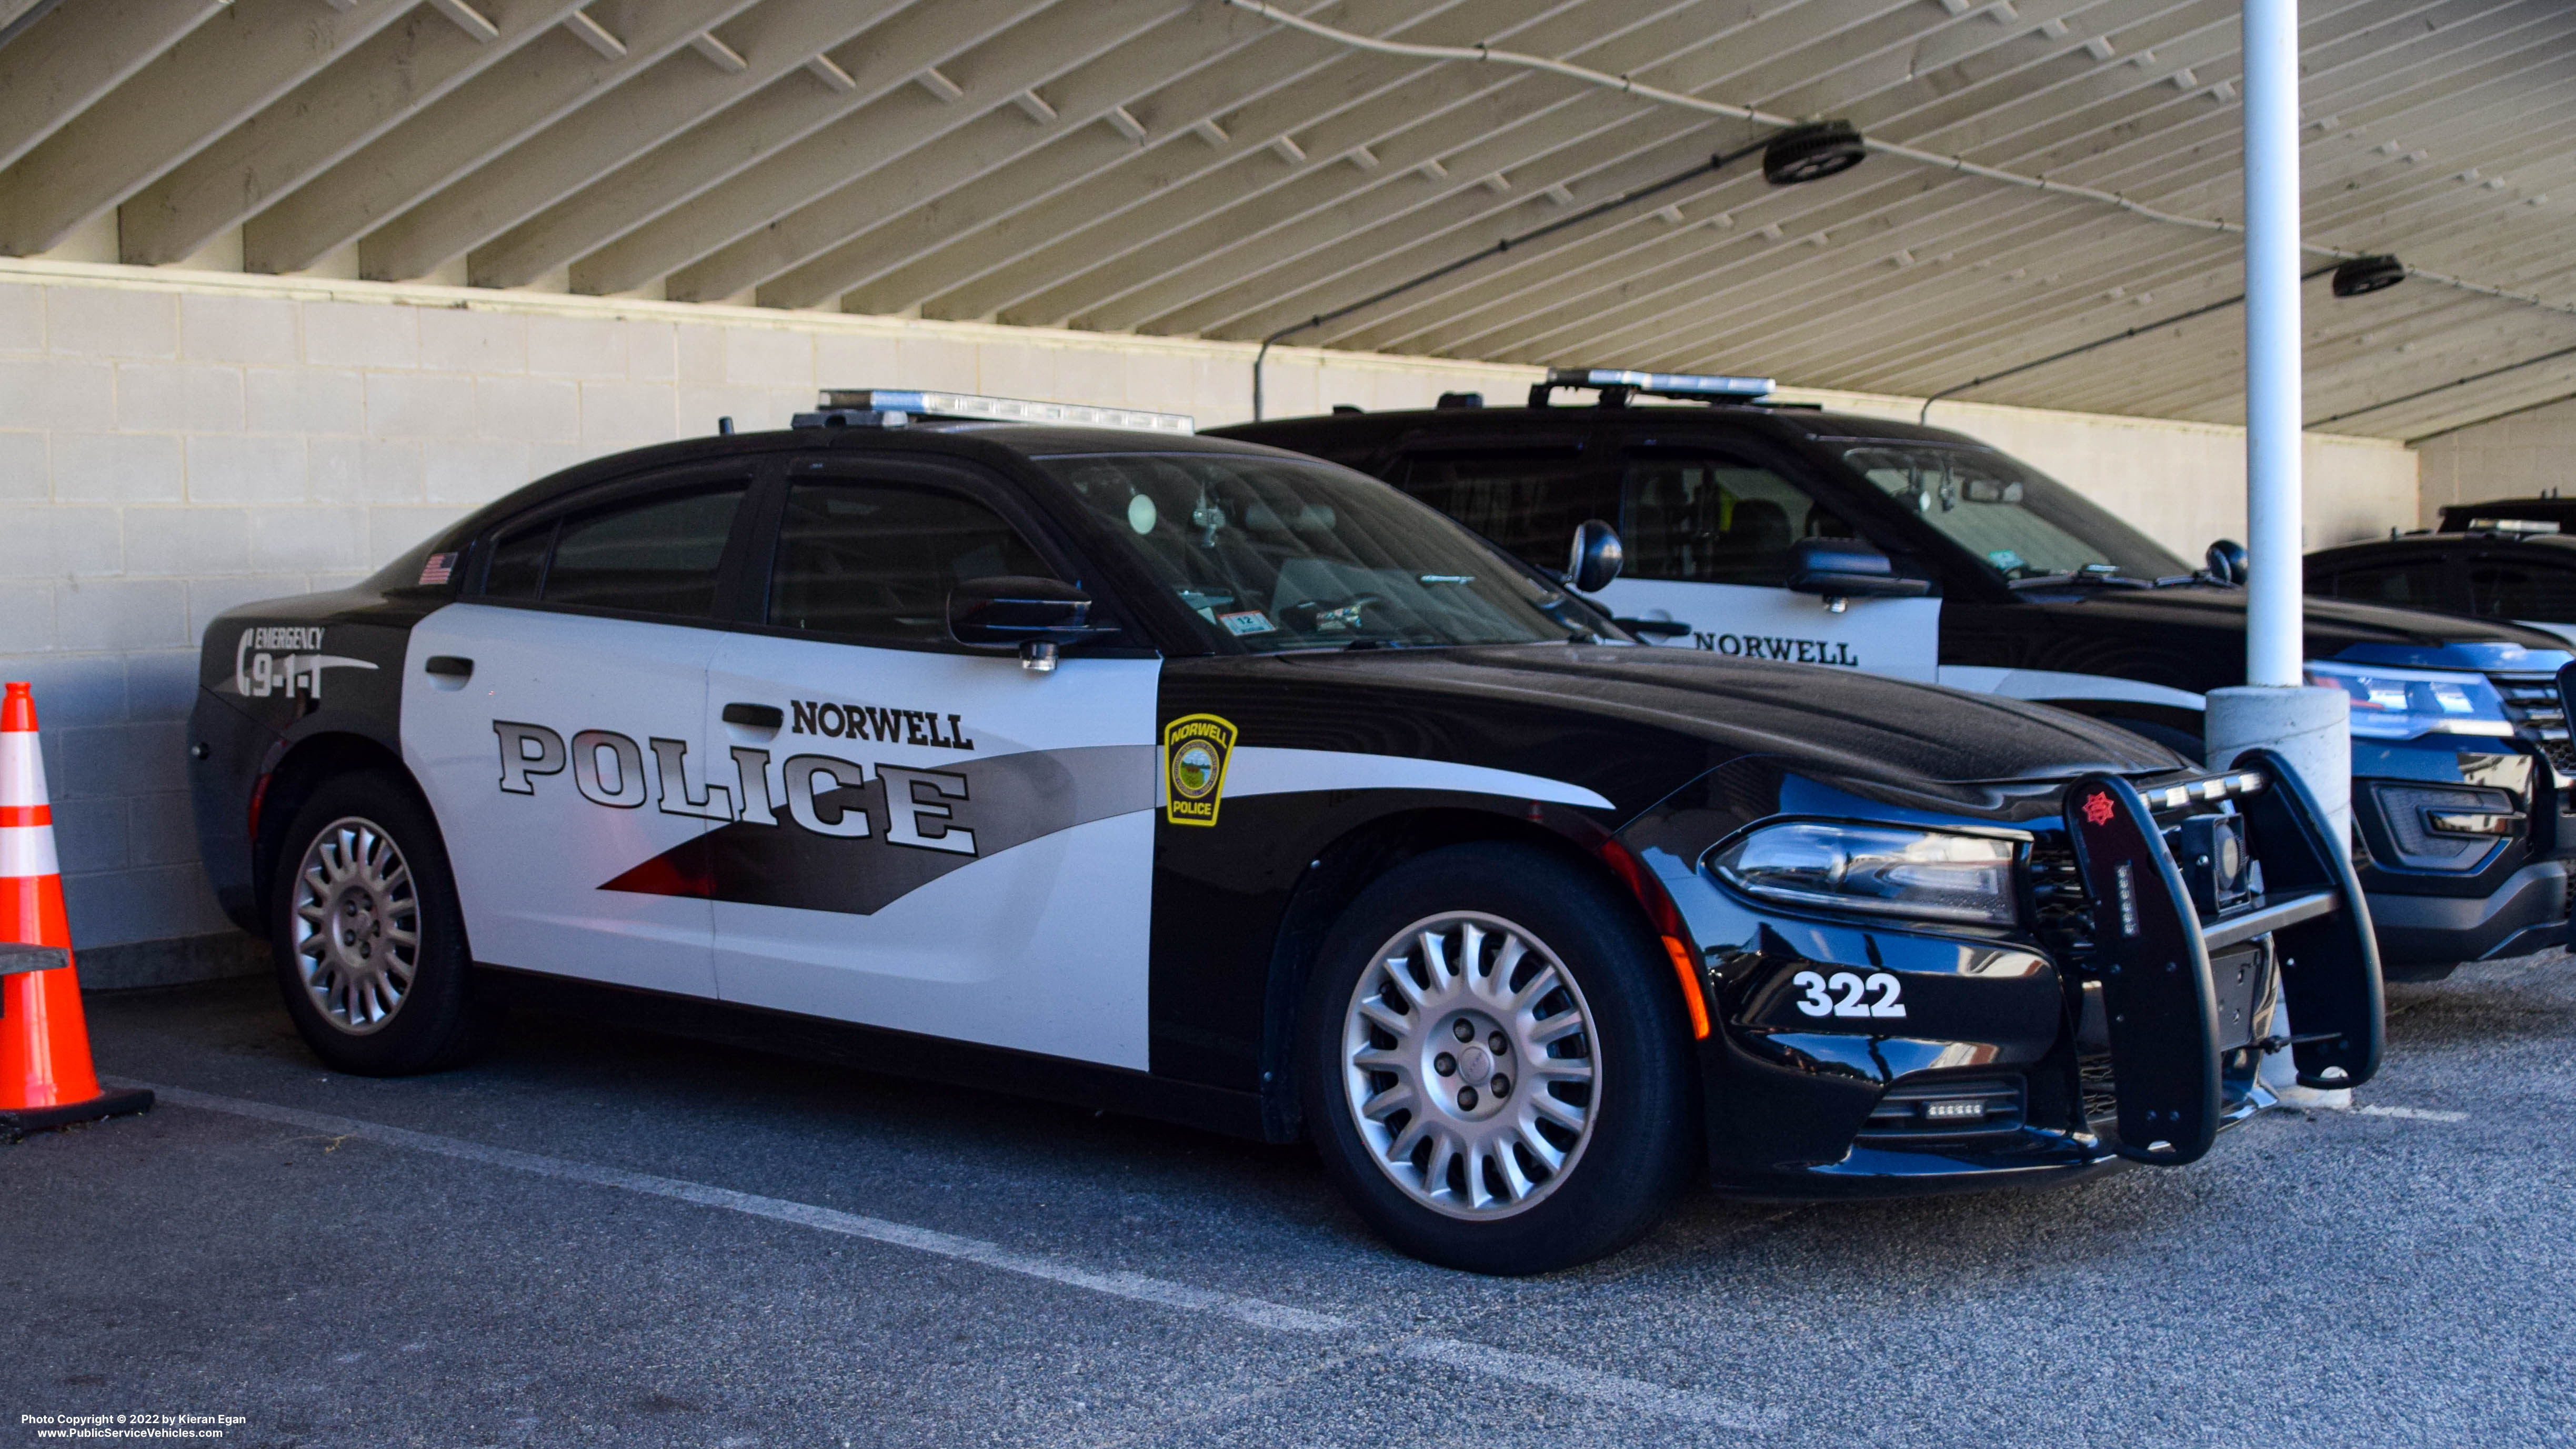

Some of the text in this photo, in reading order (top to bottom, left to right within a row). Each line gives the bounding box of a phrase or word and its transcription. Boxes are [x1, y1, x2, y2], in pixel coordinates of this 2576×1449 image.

[1237, 616, 1254, 624] 12
[254, 627, 326, 650] EMERGENCY
[1693, 632, 1859, 666] NORWELL
[253, 653, 322, 698] 9-1-1
[790, 699, 974, 751] NORWELL
[1171, 723, 1228, 749] NORWELL
[493, 718, 979, 857] POLICE
[1173, 801, 1212, 815] POLICE
[1792, 971, 1907, 1018] 322
